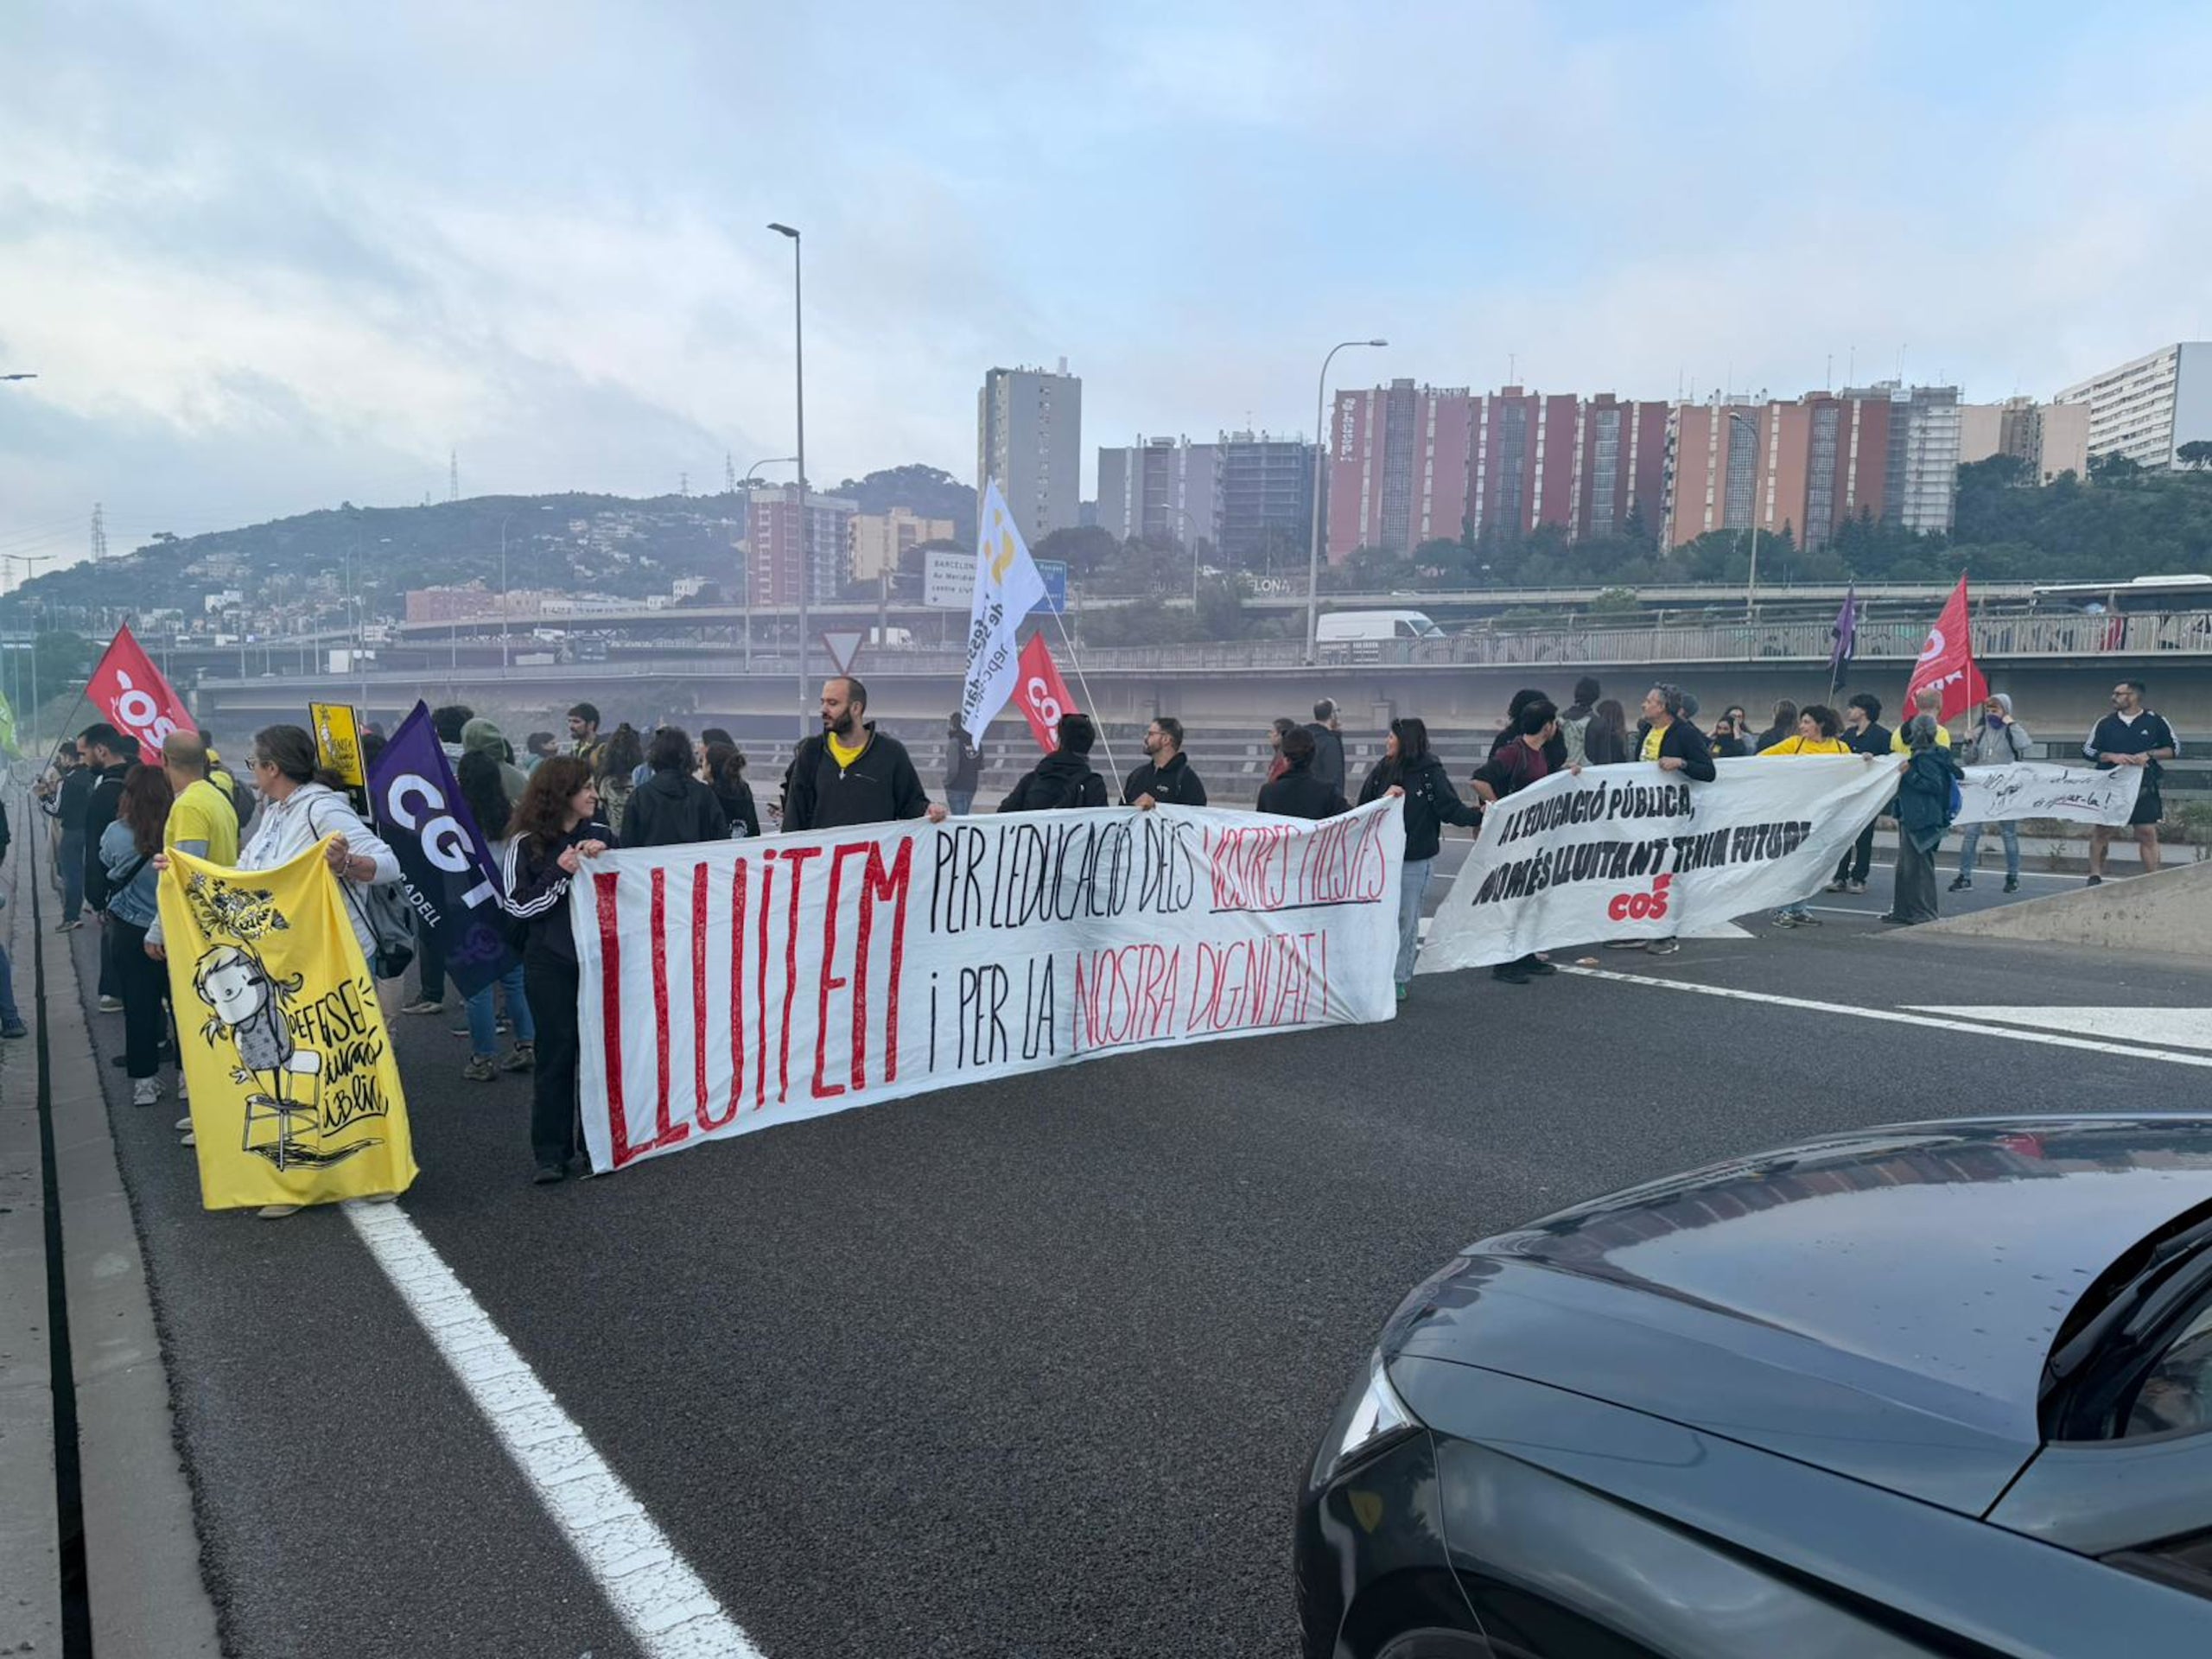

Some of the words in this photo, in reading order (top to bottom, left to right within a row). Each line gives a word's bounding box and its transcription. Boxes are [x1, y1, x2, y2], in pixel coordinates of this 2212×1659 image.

[388, 773, 504, 910] CGT
[1607, 780, 1695, 822] PÚBLICA,
[931, 825, 986, 934] PER
[991, 818, 1134, 928] L'EDUCACIÓ
[1139, 818, 1195, 914] DELS
[1471, 847, 1553, 906] NOMÉS
[1552, 837, 1669, 887] LLUITANT
[1672, 828, 1731, 874] TENIM
[957, 963, 1009, 1070] PER
[1021, 953, 1055, 1060] LA
[1072, 943, 1179, 1051] NOSTRA
